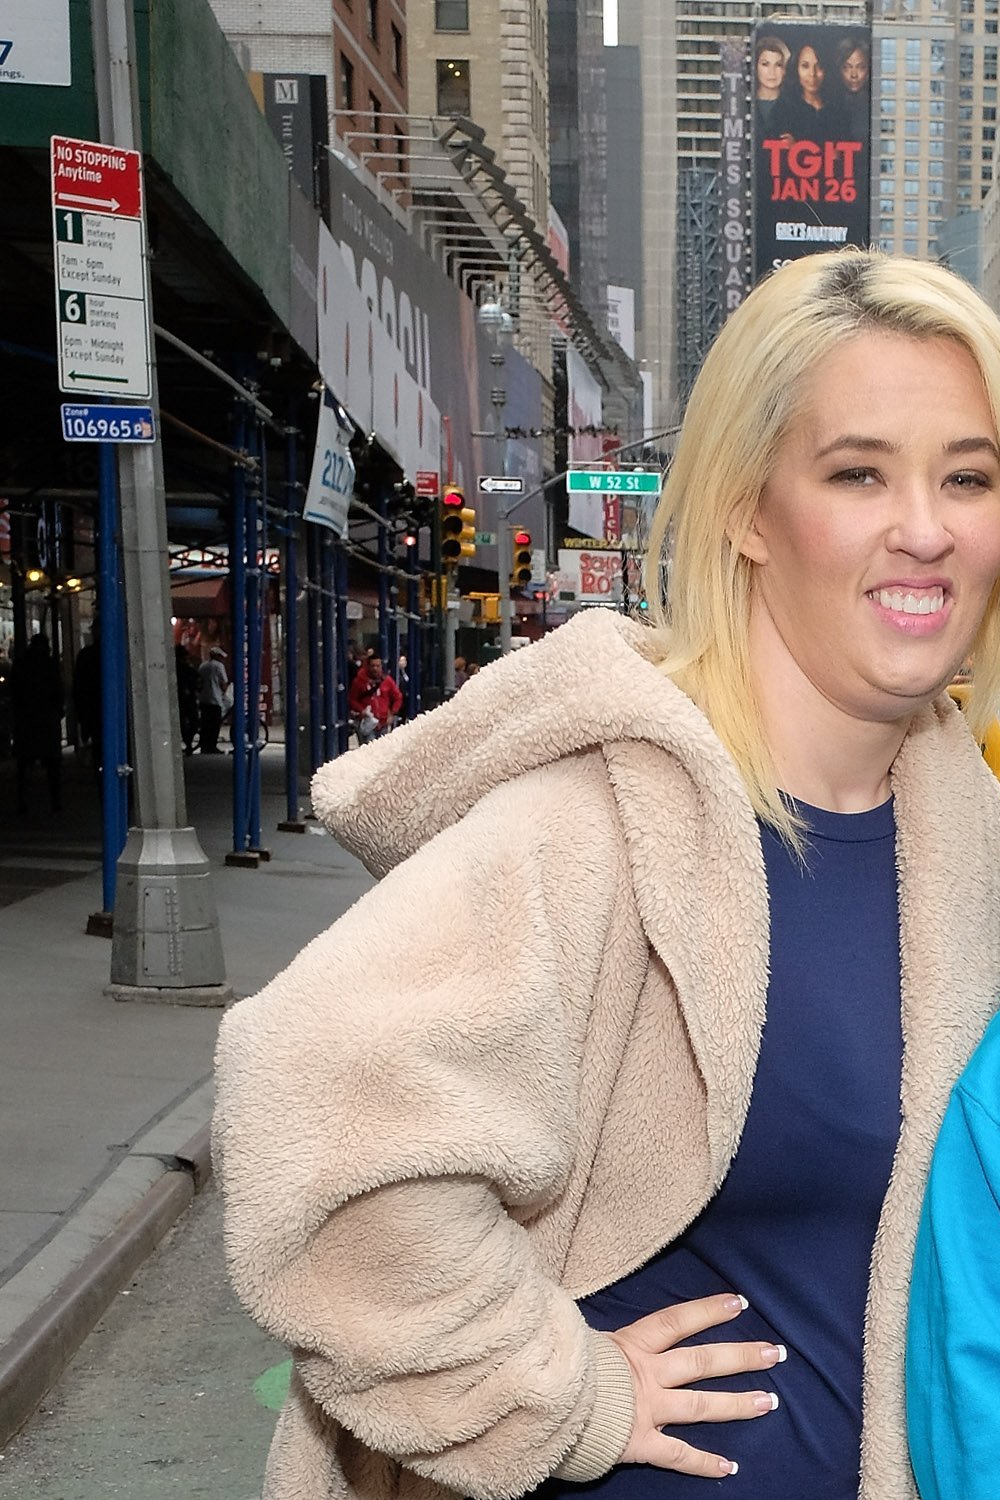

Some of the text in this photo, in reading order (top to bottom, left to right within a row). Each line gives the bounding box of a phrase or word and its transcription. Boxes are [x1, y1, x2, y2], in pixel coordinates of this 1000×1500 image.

[56, 146, 127, 171] NO STOPPING
[762, 140, 863, 177] TGIT
[58, 163, 102, 183] Anytime
[723, 73, 745, 309] TIMES SQUAR
[771, 178, 857, 202] JAN 26
[63, 213, 74, 240] 1
[87, 240, 113, 250] parking
[61, 255, 78, 266] 7am
[86, 258, 104, 270] 6pm
[61, 267, 121, 286] Except Sunday
[65, 293, 80, 321] 6
[90, 320, 117, 330] parking
[64, 336, 82, 347] 6pm
[91, 338, 124, 351] Midnight
[64, 348, 125, 365] Except Sunday
[65, 418, 131, 437] 106965
[589, 476, 639, 490] W 52 St
